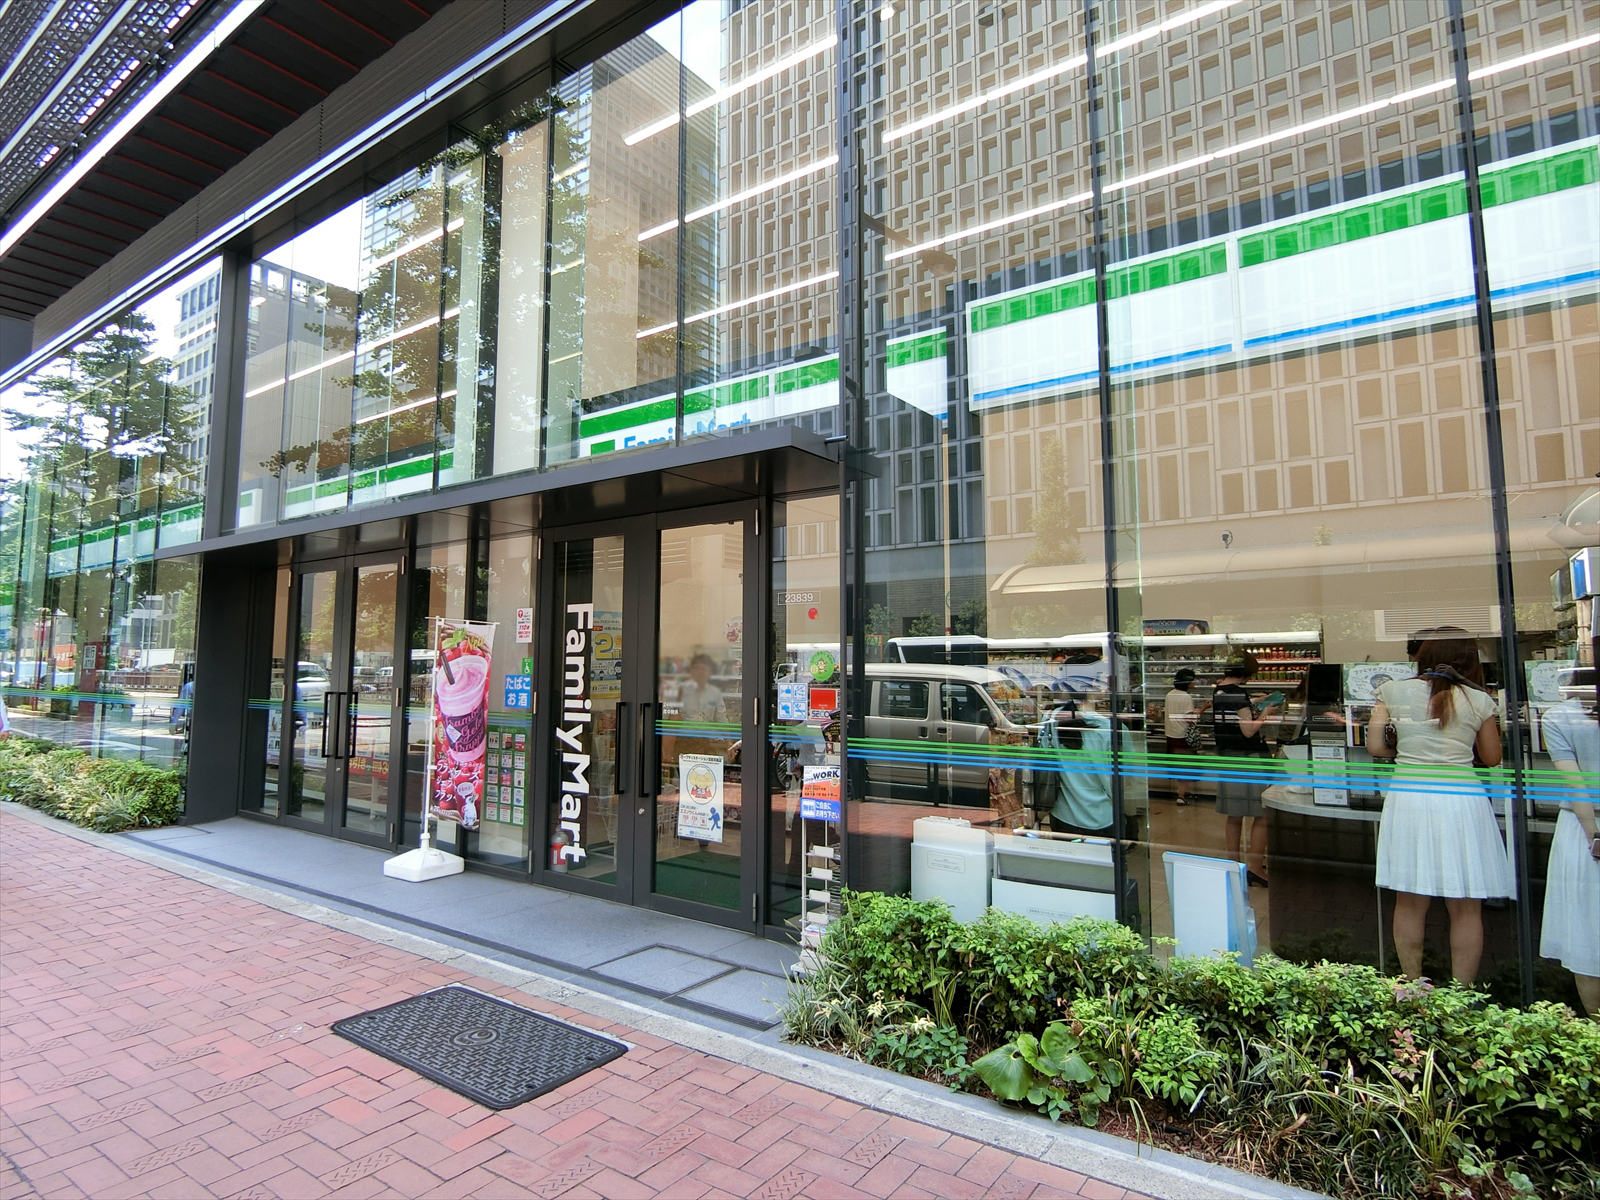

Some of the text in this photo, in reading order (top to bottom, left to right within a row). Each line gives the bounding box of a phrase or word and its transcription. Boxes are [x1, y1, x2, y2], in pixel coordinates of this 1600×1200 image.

[784, 592, 814, 603] 23839
[505, 676, 531, 690] たばこ
[507, 692, 528, 707] お酒
[811, 709, 831, 717] SECO
[555, 602, 594, 864] FamilyMart
[813, 769, 840, 780] WORK
